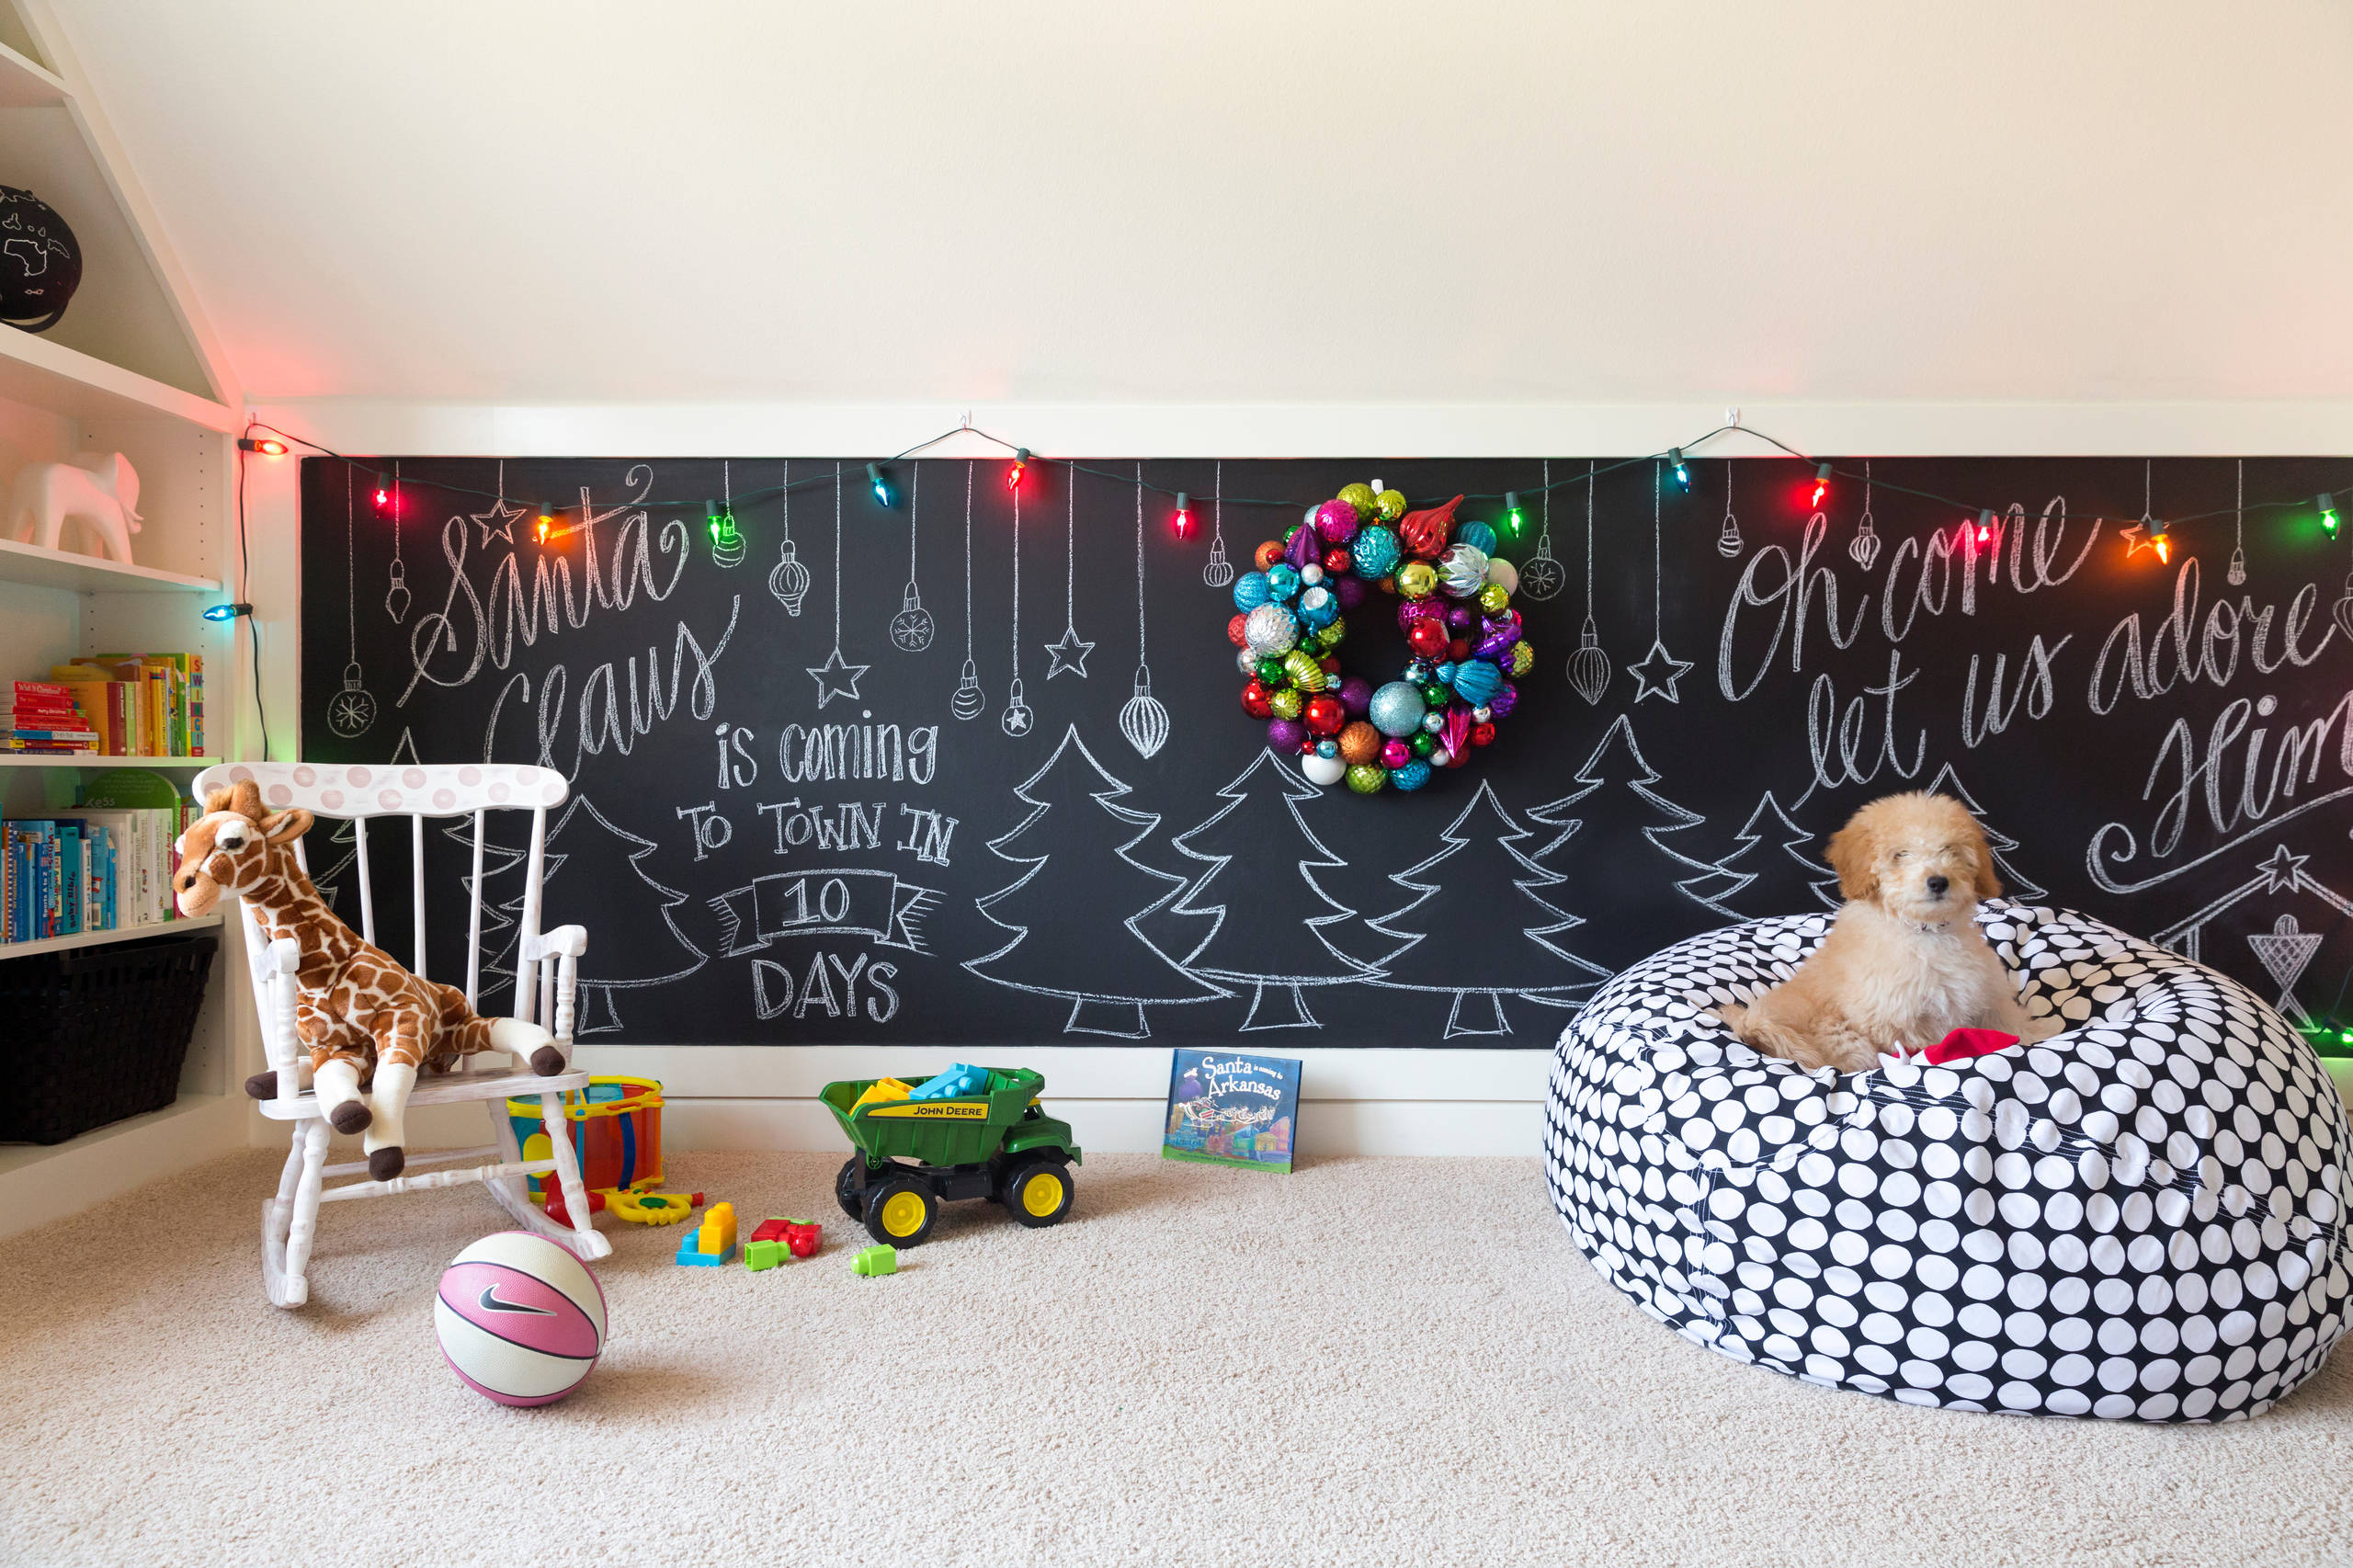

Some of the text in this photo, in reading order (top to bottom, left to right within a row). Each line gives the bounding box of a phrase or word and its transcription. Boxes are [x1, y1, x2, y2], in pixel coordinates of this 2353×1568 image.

[396, 463, 688, 707] Santa
[1718, 495, 2103, 701] Oh come
[1790, 556, 2337, 812] let us adore
[715, 710, 939, 790] is coming
[897, 808, 959, 866] IN
[783, 878, 849, 926] 10
[750, 950, 898, 1024] DAYS
[1201, 1056, 1253, 1079] Santa
[1208, 1074, 1281, 1100] Arkansas
[914, 1107, 983, 1116] JOHN DEERE
